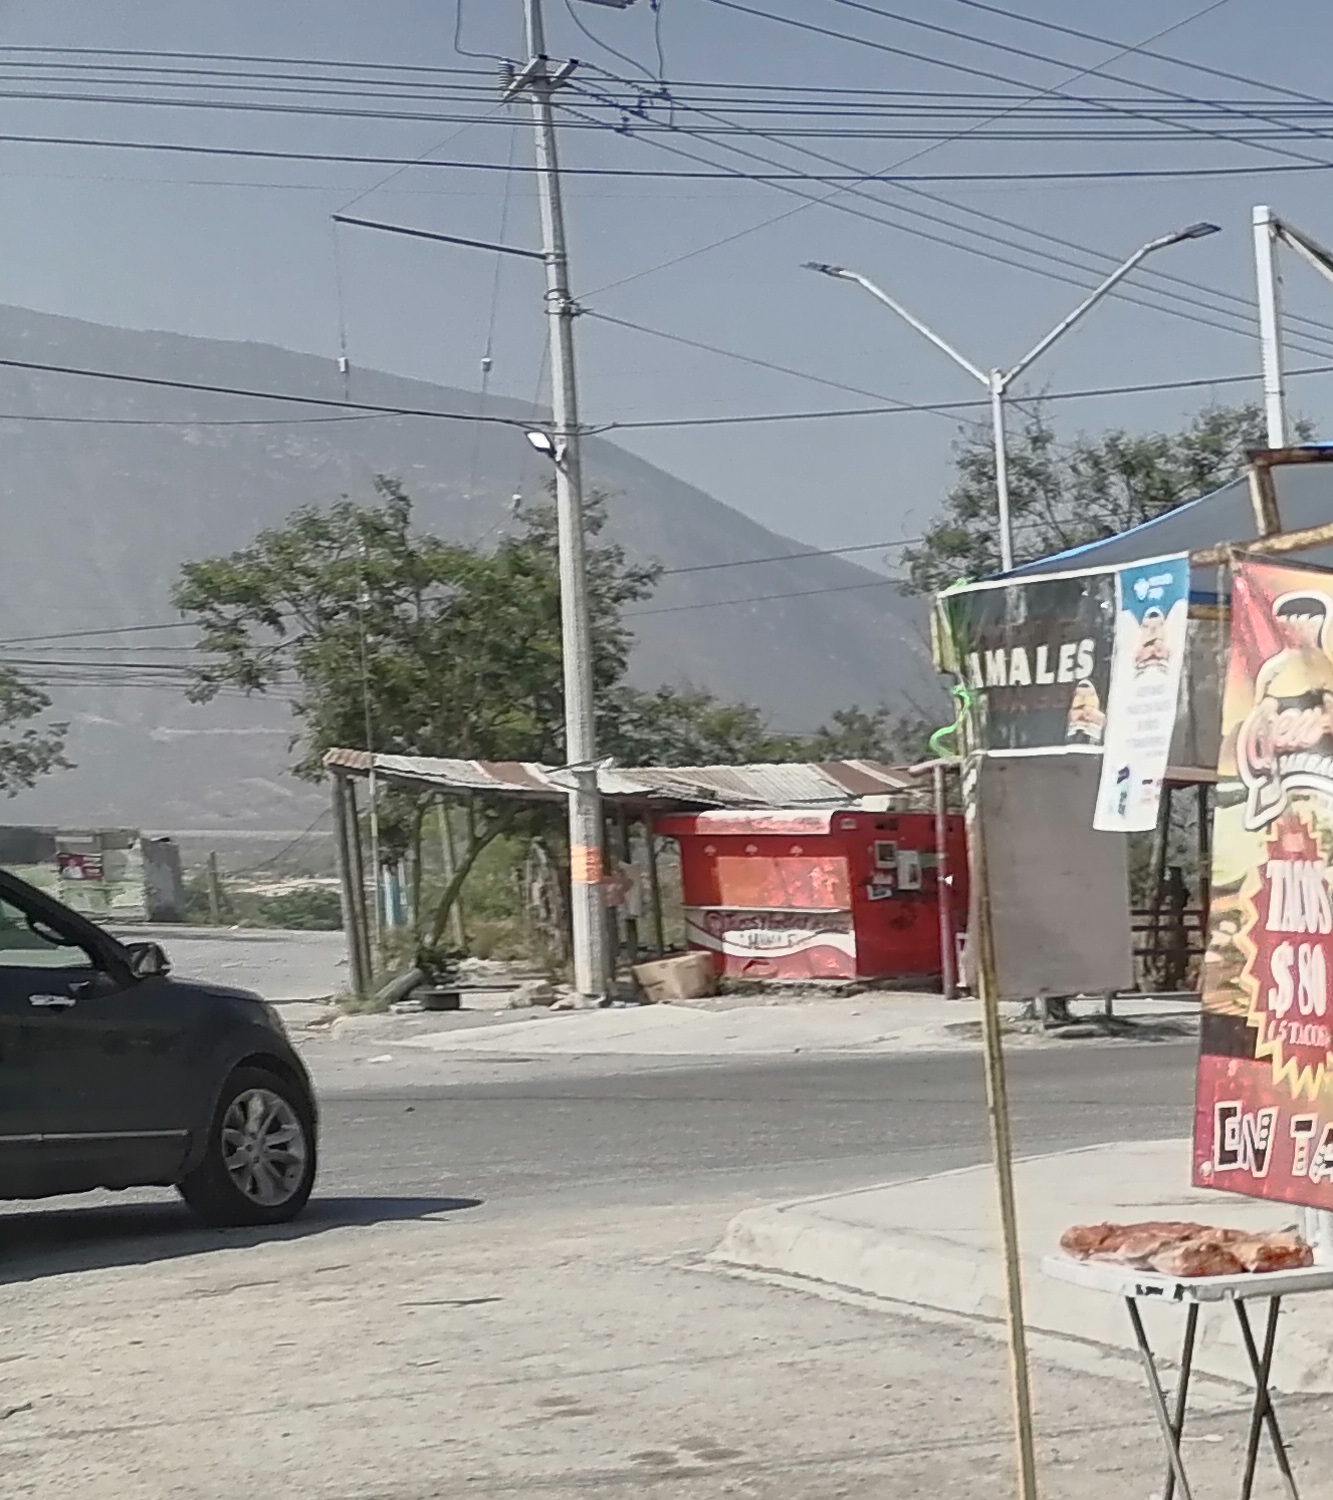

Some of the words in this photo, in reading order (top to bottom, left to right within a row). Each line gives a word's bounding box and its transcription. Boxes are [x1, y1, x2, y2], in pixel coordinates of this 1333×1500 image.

[964, 638, 1096, 688] AMALES
[1265, 859, 1333, 935] TACOS
[1213, 1100, 1280, 1178] EN
